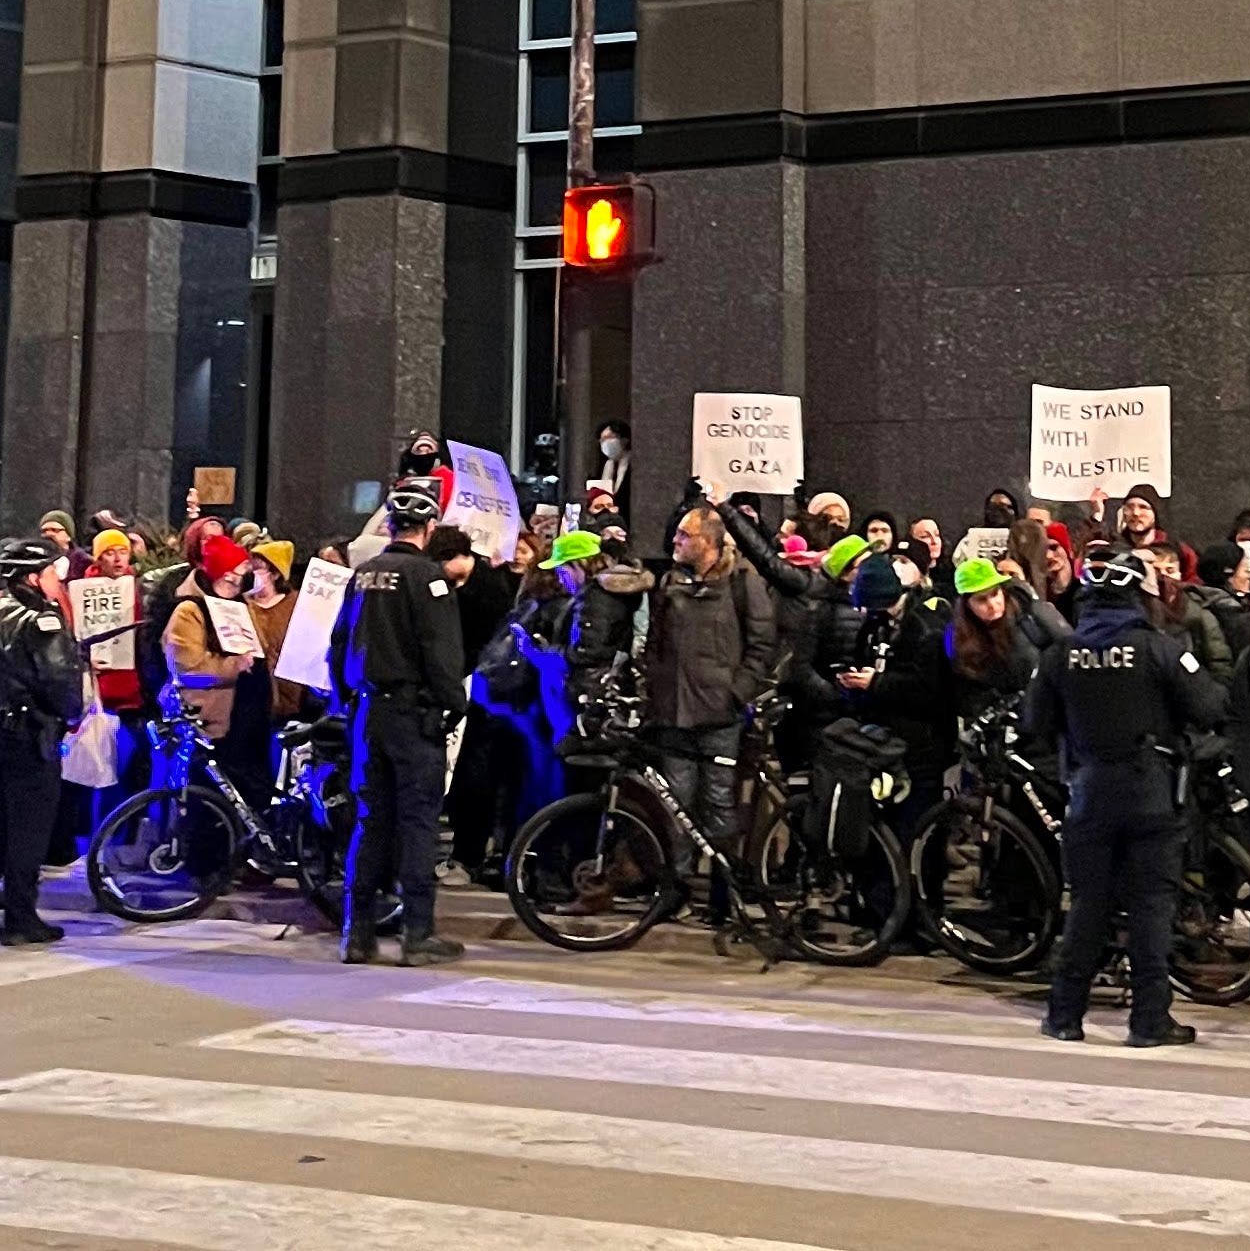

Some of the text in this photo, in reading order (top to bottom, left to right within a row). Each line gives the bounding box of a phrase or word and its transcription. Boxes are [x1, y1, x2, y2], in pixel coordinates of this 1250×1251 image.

[731, 406, 773, 421] STOP
[1043, 401, 1144, 420] WE STAND
[706, 423, 790, 440] GENOCIDE
[1041, 429, 1088, 447] WITH
[748, 441, 766, 456] IN
[728, 459, 783, 475] GAZA
[1042, 456, 1150, 478] PALESTINE
[83, 587, 121, 597] CEASE
[83, 597, 121, 613] FIRE
[1069, 647, 1135, 669] POLICE
